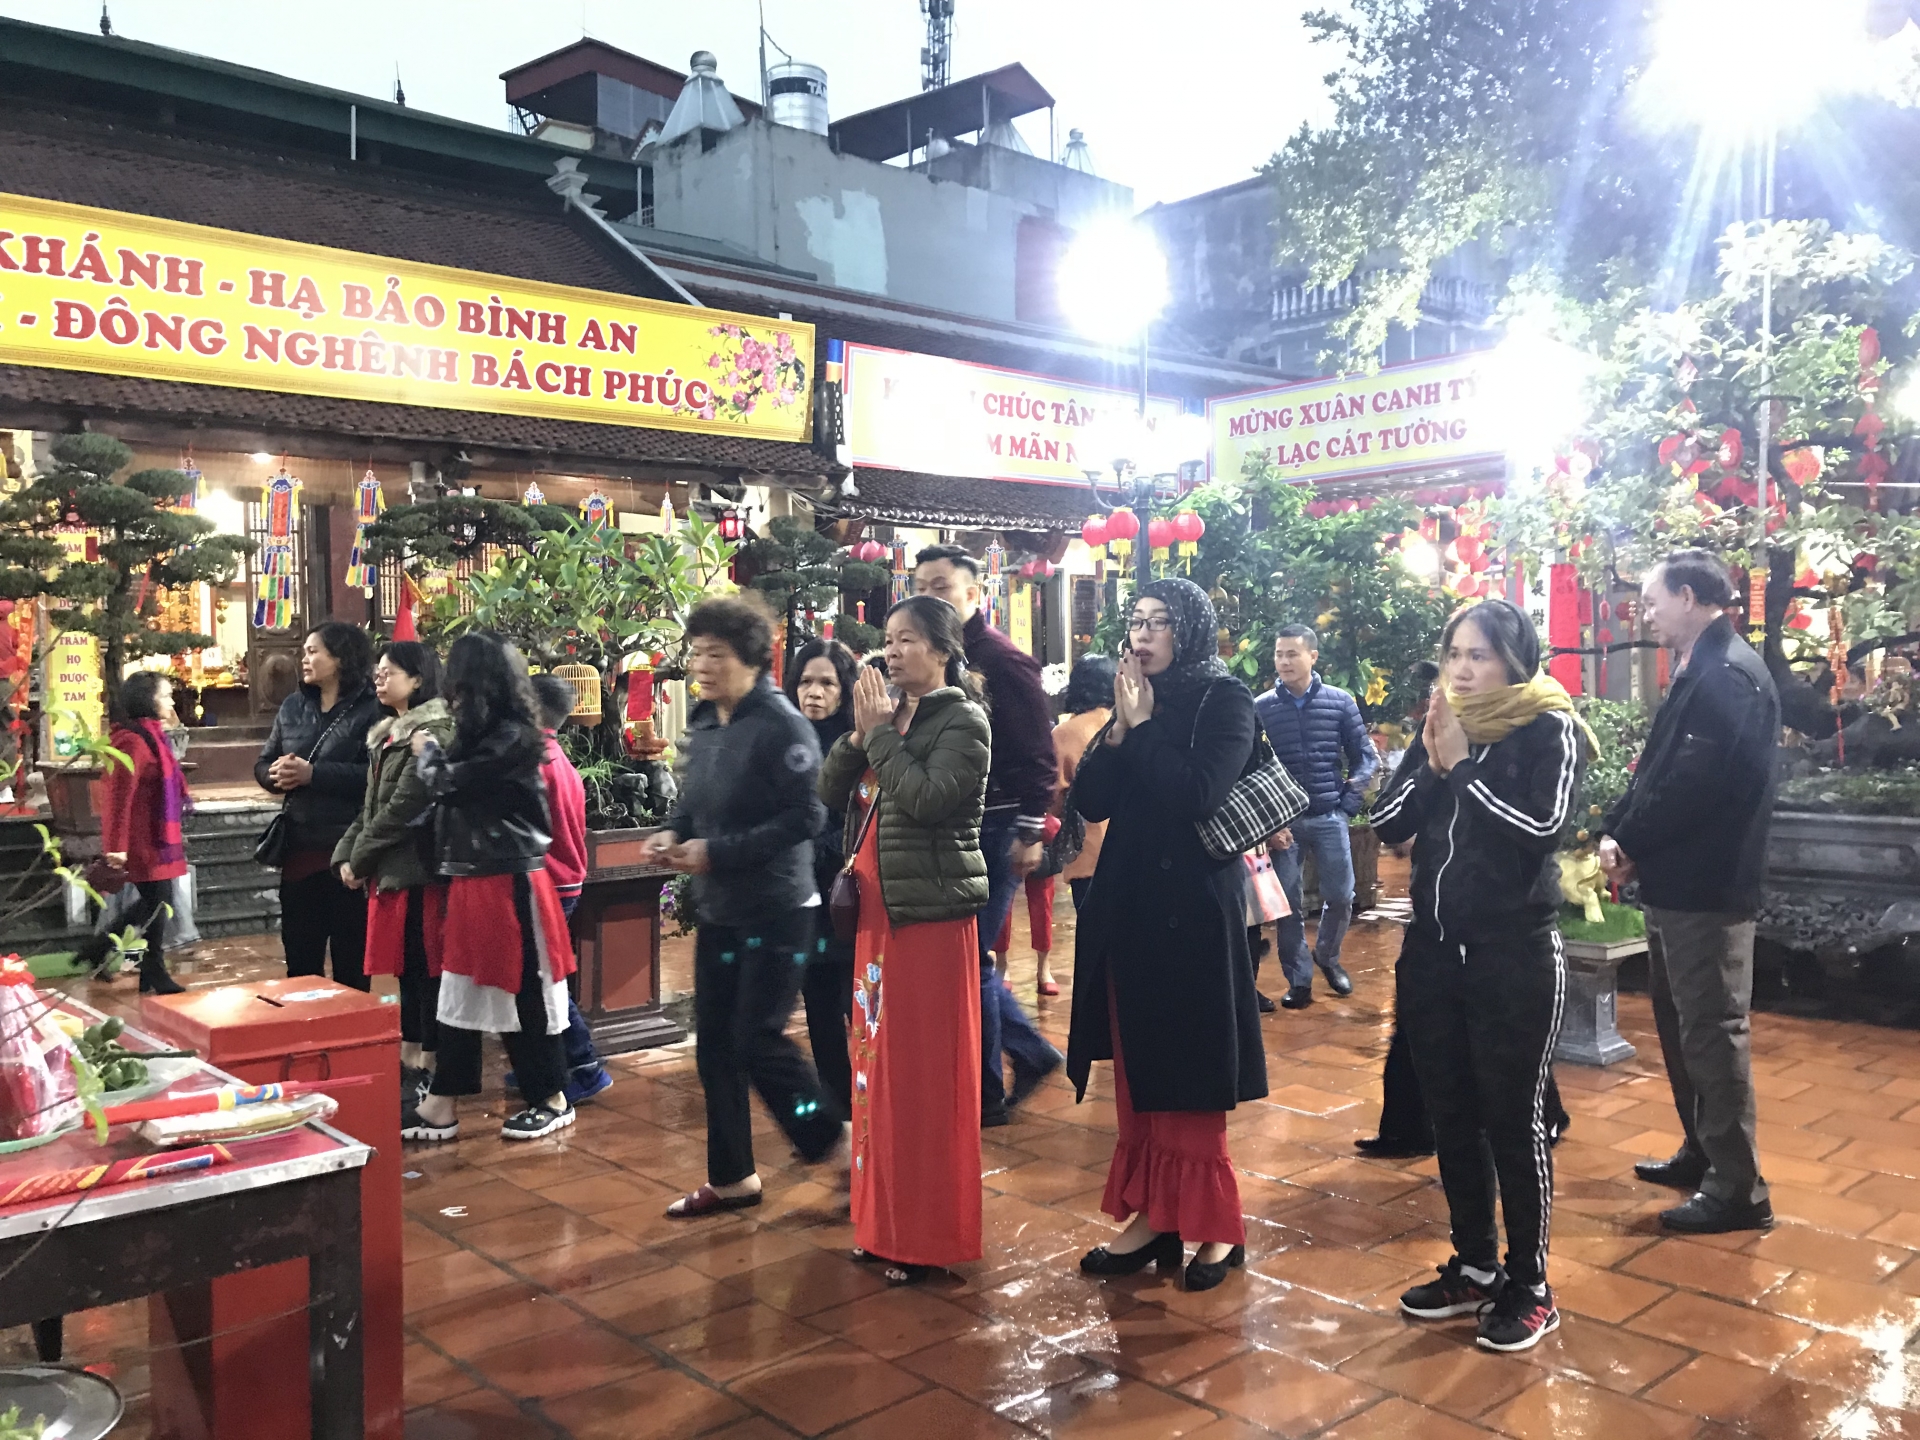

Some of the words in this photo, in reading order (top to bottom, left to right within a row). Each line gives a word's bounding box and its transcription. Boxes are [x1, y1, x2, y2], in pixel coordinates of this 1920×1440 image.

[249, 270, 325, 319] HẠ
[342, 276, 446, 328] BẢO
[457, 295, 568, 346] BÌNH
[577, 319, 638, 355] AN
[53, 297, 227, 356] ĐÔNG
[244, 325, 459, 384] NGHÊNH
[471, 349, 592, 397] BÁCH
[603, 368, 708, 411] PHÚC
[982, 391, 1045, 422] CHÚC
[1051, 398, 1095, 427] TÂN
[1228, 408, 1294, 437] MỪNG
[1299, 392, 1366, 426] XUÂN
[1371, 381, 1442, 413] CANH
[1009, 432, 1060, 462] MÃN
[1277, 440, 1321, 469] LẠC
[1326, 428, 1374, 459] CÁT
[1377, 416, 1468, 451] TƯỜNG
[66, 655, 82, 666] HỌ
